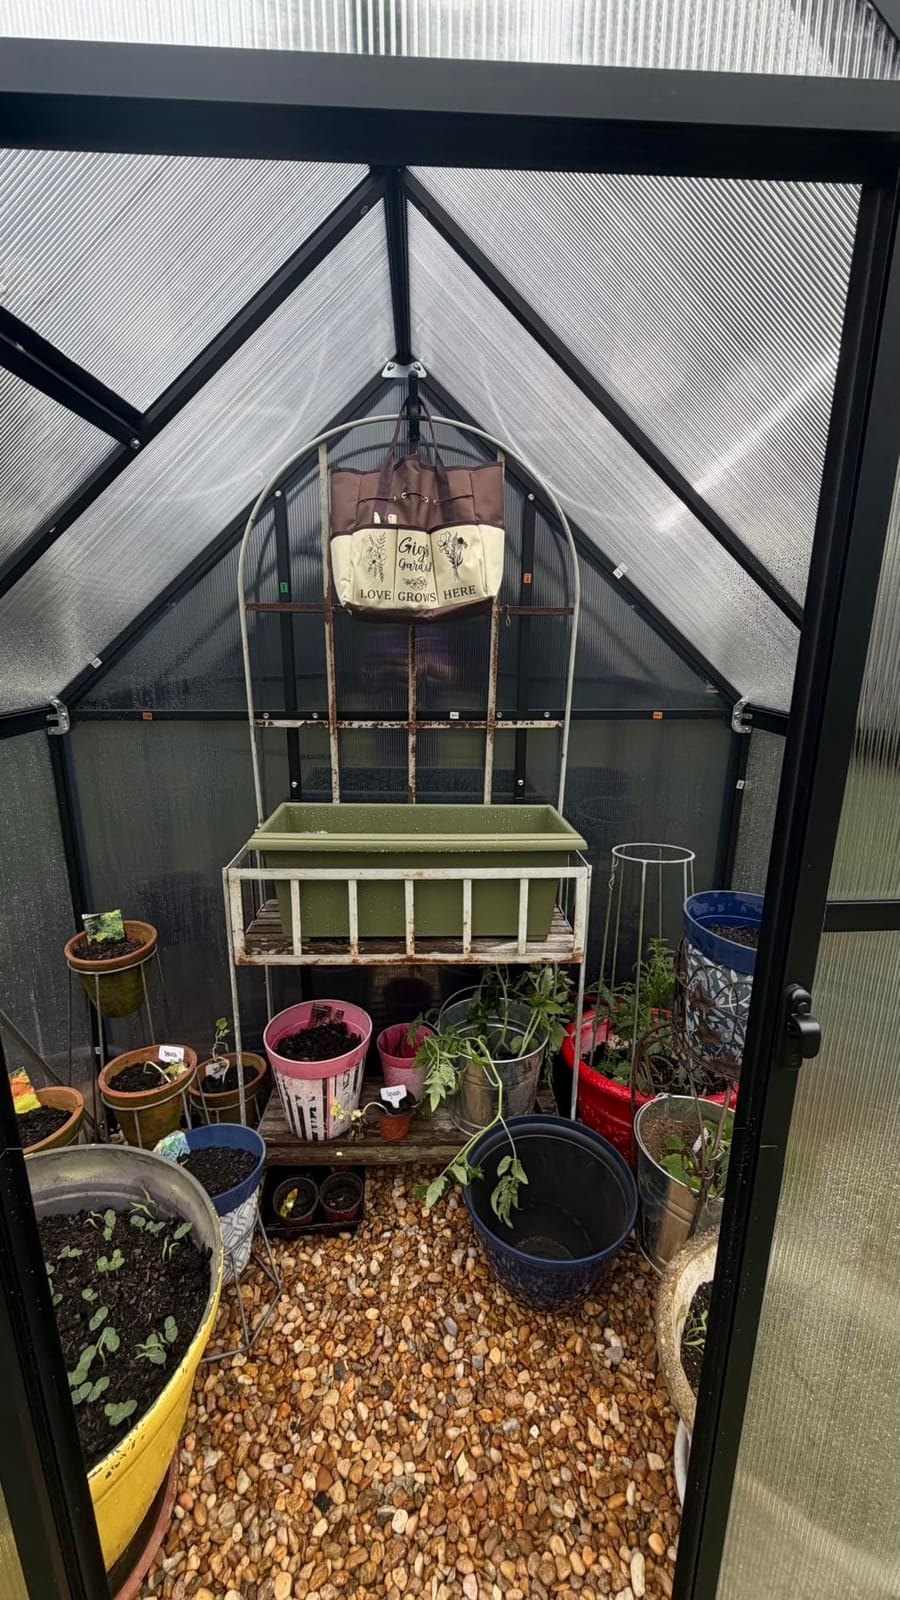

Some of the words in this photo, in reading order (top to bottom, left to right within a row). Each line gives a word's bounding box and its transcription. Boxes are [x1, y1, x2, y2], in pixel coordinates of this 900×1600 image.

[360, 589, 392, 601] LOVE
[397, 591, 437, 602] GROWS
[443, 584, 477, 600] HERE
